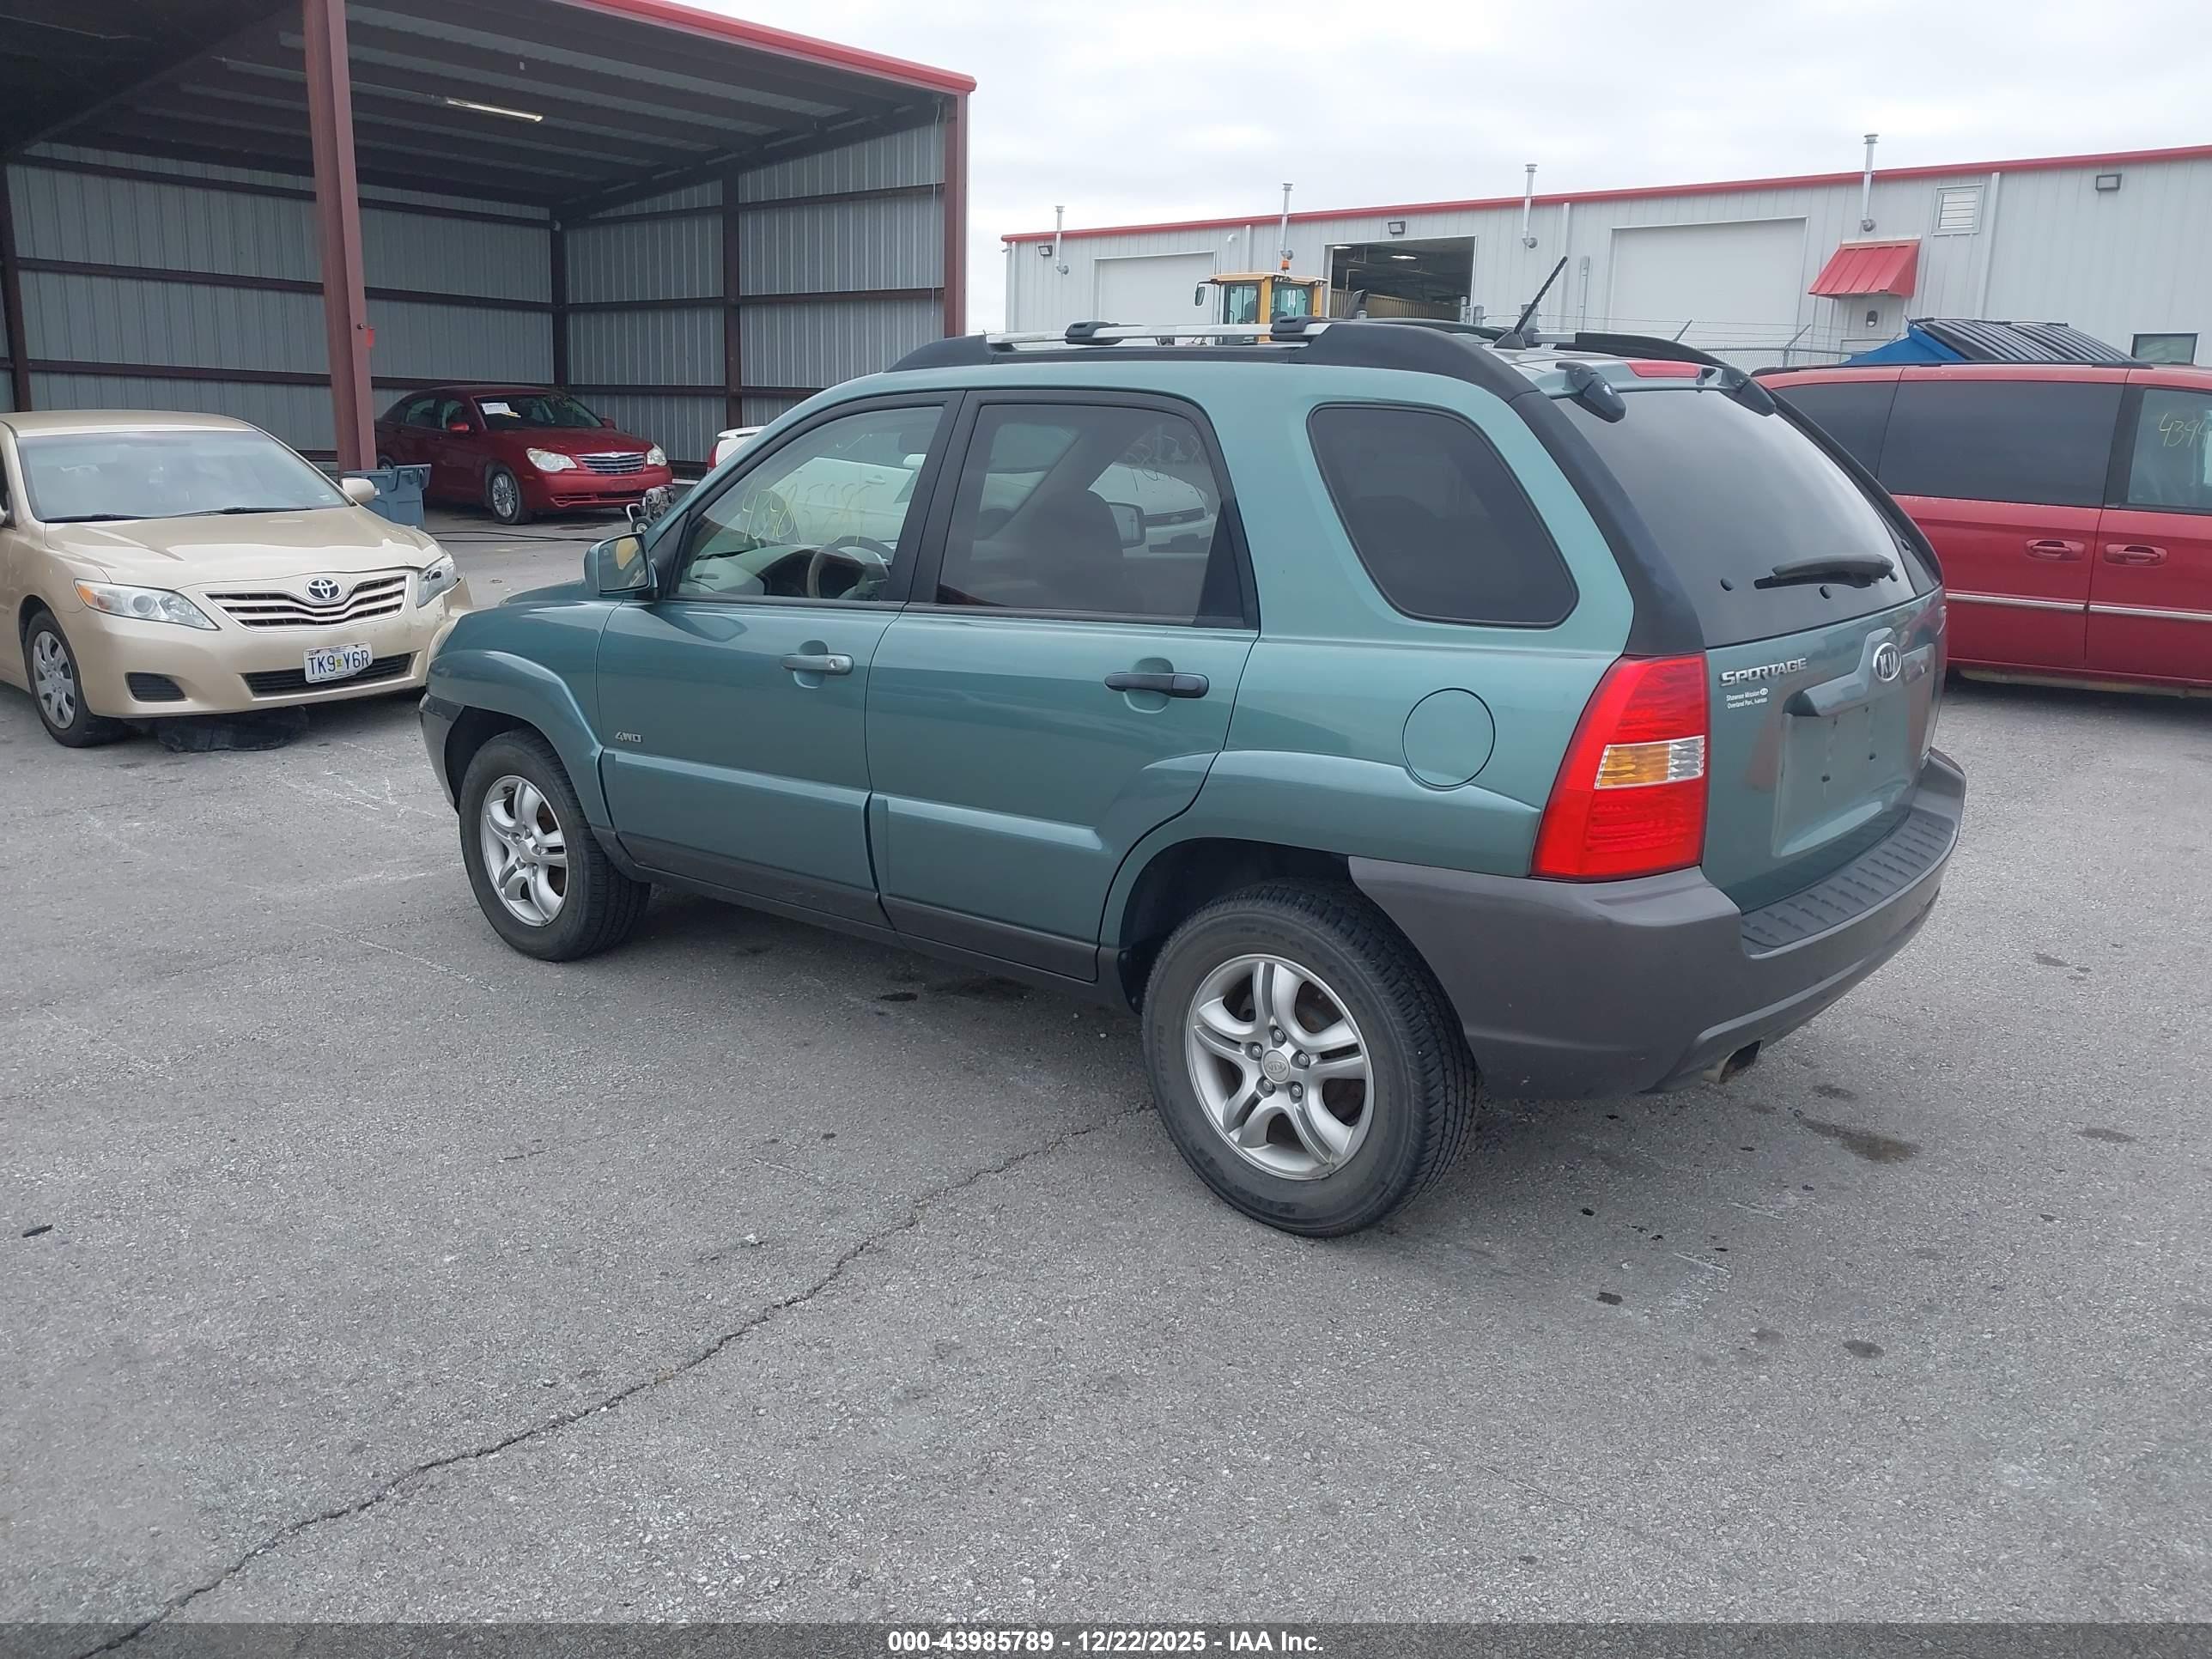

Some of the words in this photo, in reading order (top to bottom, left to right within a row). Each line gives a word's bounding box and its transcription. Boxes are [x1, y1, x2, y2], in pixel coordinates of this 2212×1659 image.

[307, 654, 337, 676] TK9
[343, 649, 370, 670] Y6R
[1720, 657, 1808, 687] SPORTAGE
[615, 731, 642, 743] 4WD
